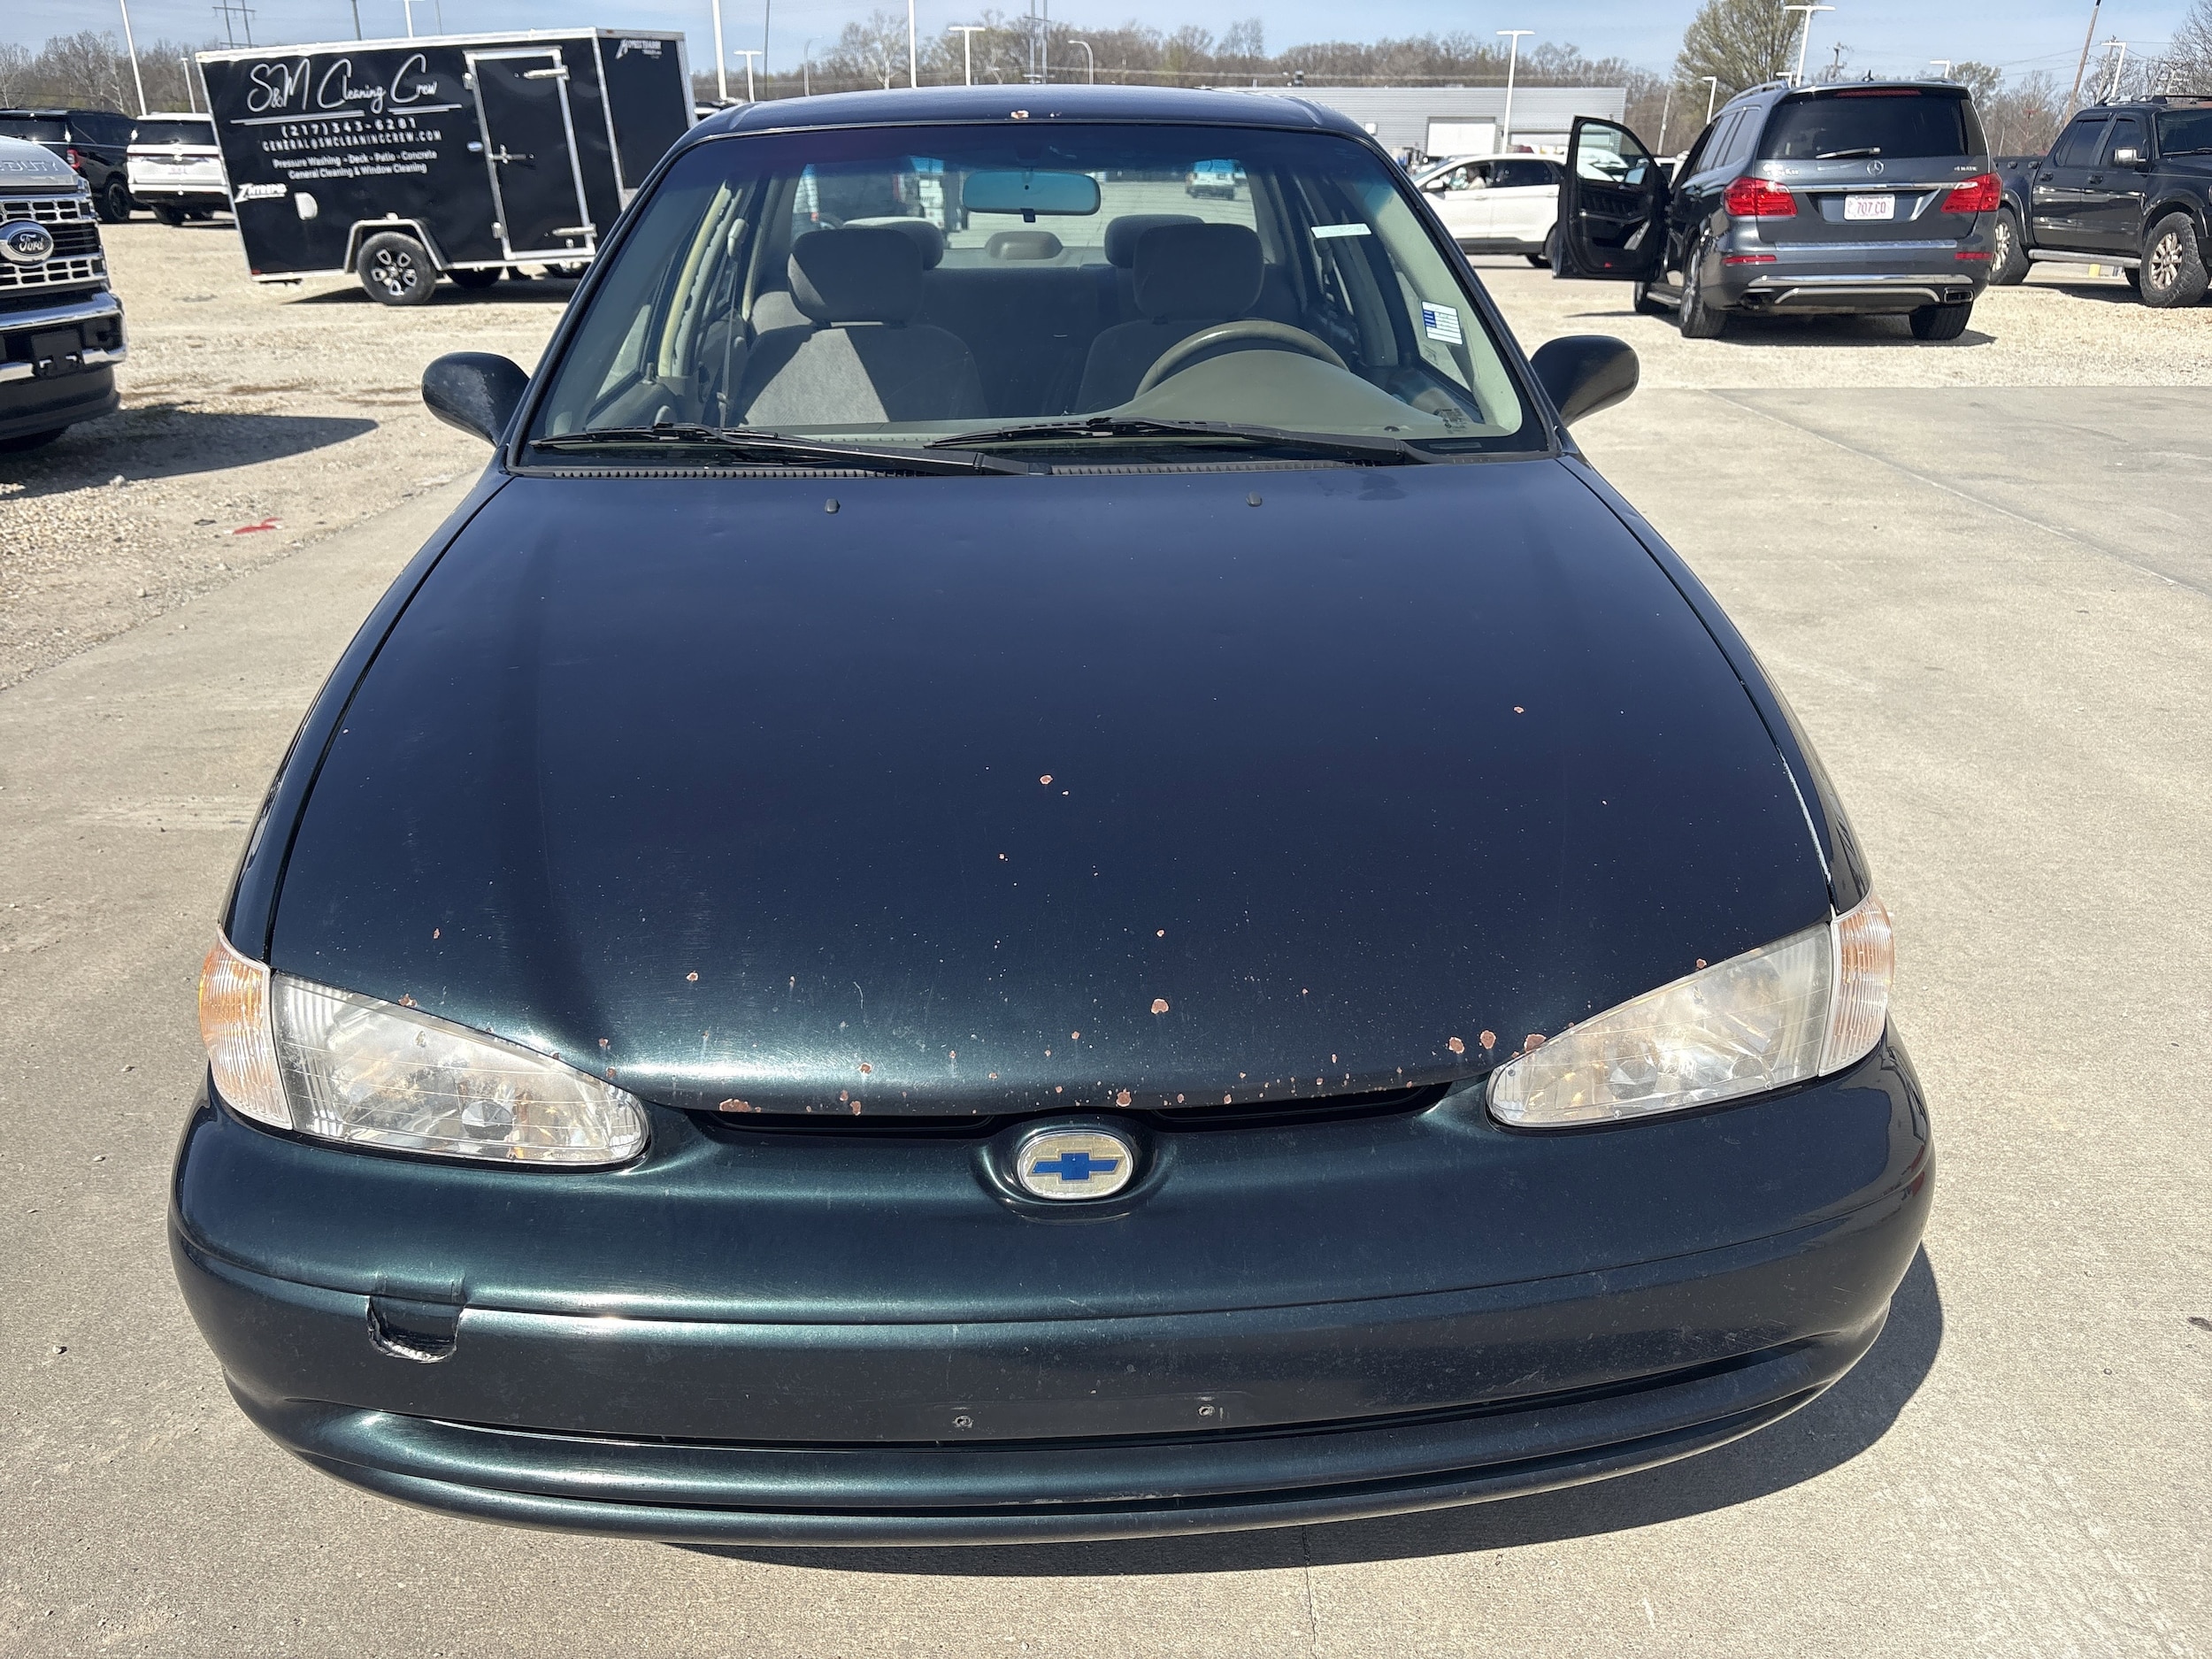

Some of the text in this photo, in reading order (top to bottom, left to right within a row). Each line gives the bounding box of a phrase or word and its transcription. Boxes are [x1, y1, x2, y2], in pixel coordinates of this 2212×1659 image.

[247, 53, 438, 114] S&M Cleaning Crew
[272, 158, 307, 169] Pressure
[306, 155, 342, 167] Washing
[347, 152, 370, 165] Deck
[373, 151, 396, 162] Patio
[400, 149, 438, 160] Concrete
[288, 167, 319, 180] General
[319, 166, 354, 179] Cleaning
[359, 164, 393, 175] Window
[392, 161, 428, 174] Cleaning
[19, 233, 45, 252] Ford
